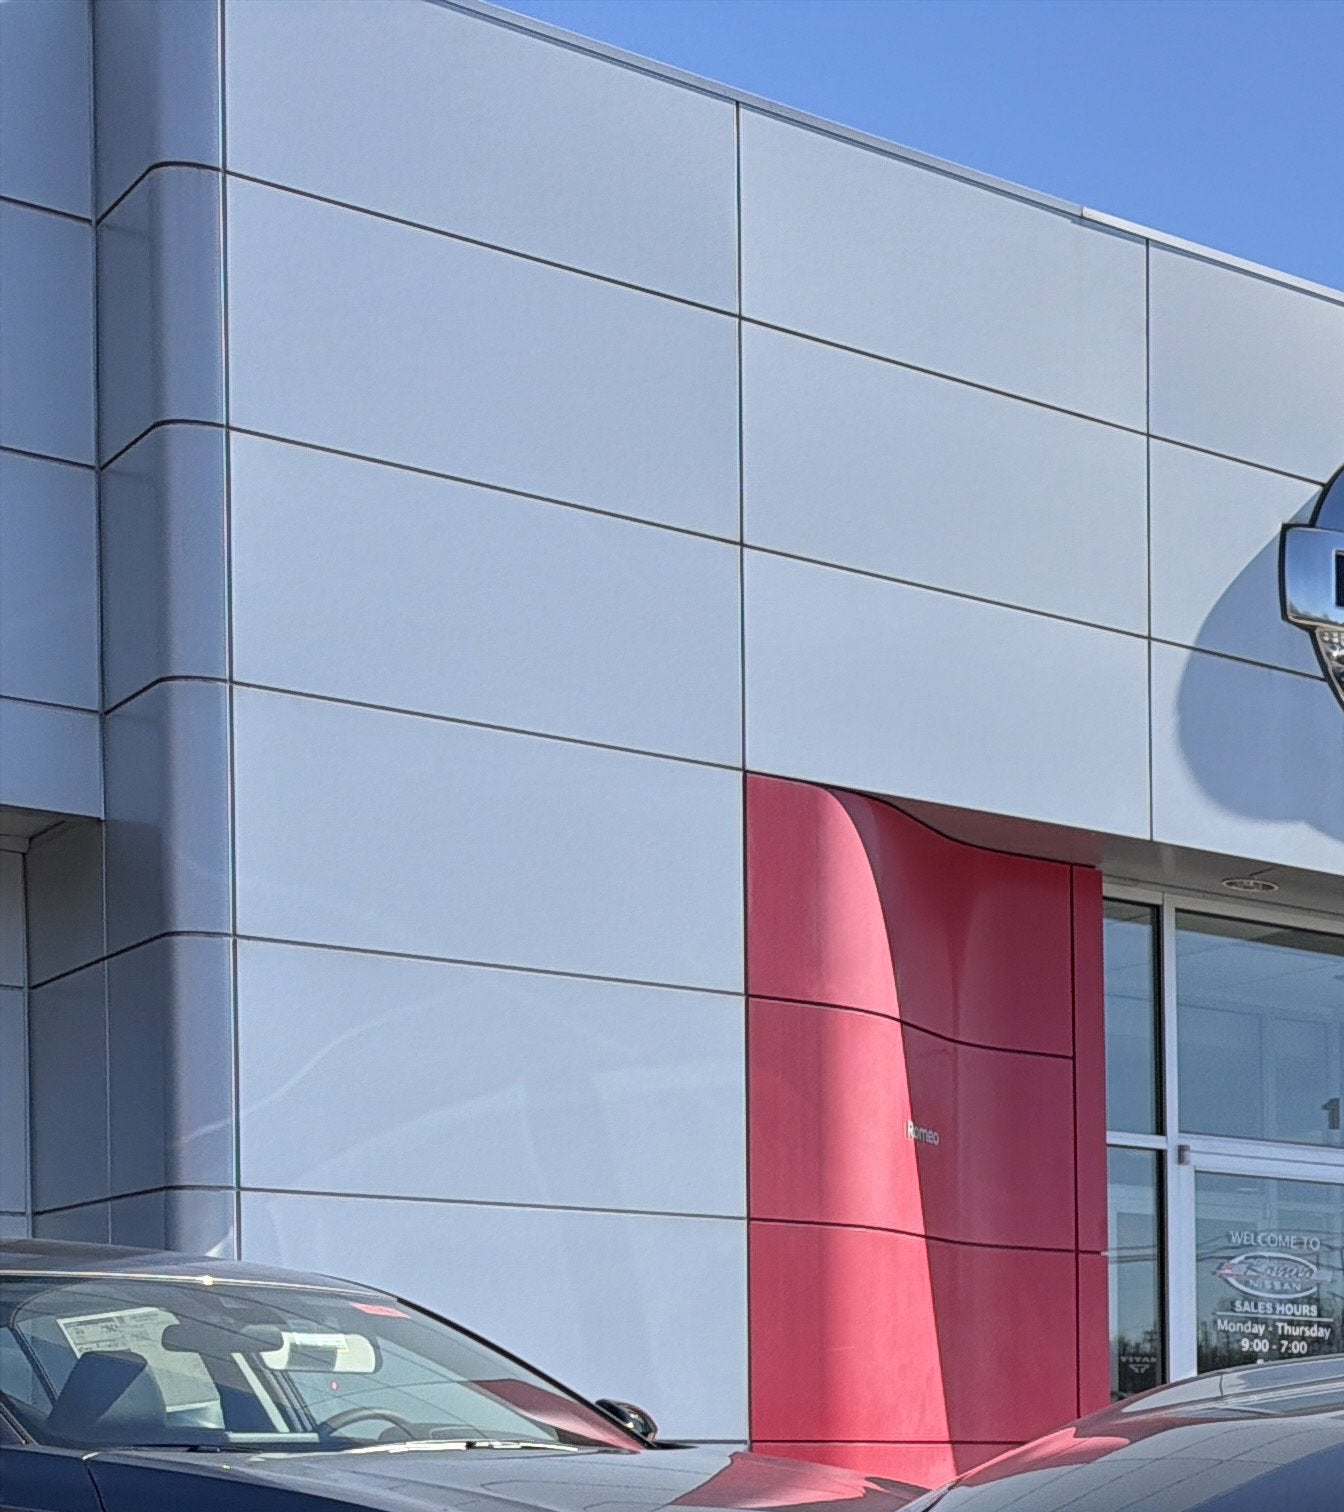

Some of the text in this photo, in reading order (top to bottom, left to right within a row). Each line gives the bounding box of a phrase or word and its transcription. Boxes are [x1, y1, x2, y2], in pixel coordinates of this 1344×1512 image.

[1230, 1230, 1320, 1251] WELCOME TO
[1249, 1279, 1301, 1292] NISSAN
[1234, 1300, 1318, 1317] SALES HOURS
[1217, 1319, 1266, 1335] Monday
[1276, 1321, 1332, 1340] Thursday
[1241, 1337, 1270, 1352] 9:00
[1279, 1340, 1308, 1354] 7:00
